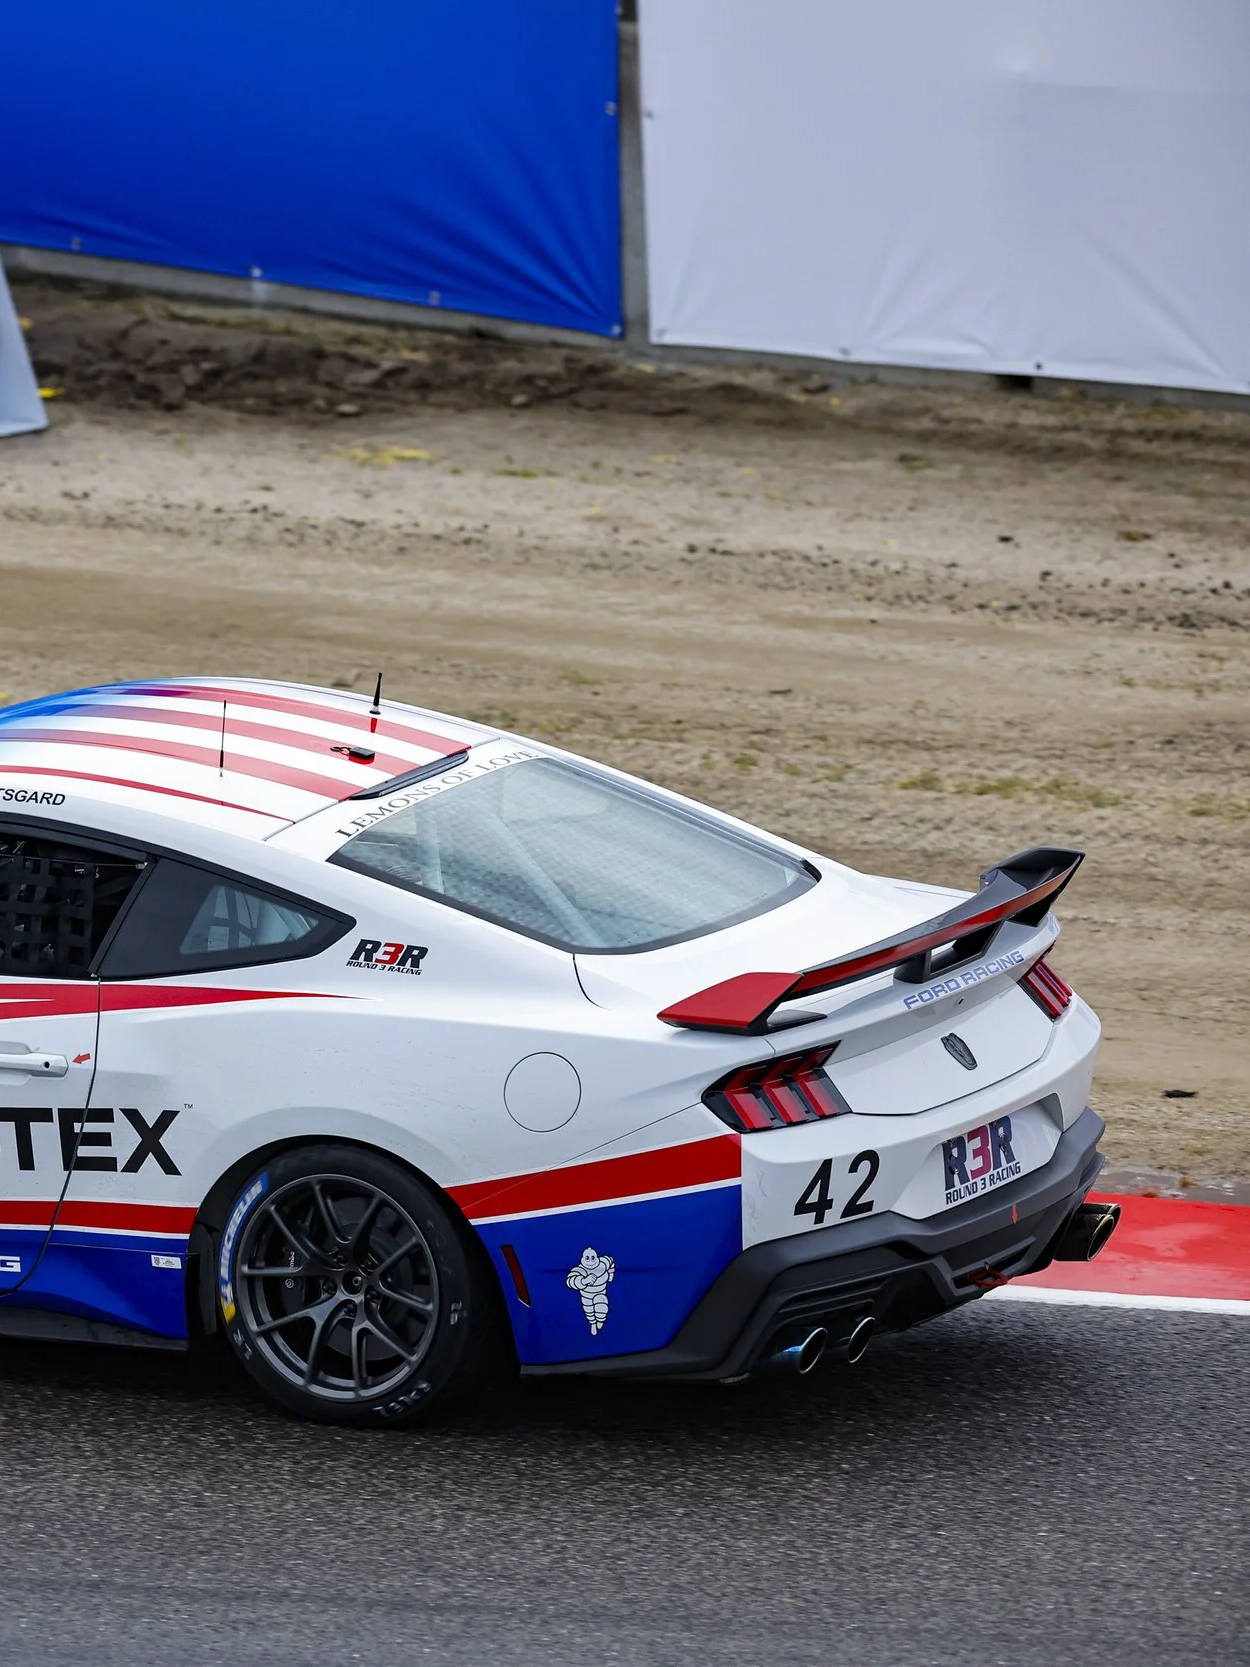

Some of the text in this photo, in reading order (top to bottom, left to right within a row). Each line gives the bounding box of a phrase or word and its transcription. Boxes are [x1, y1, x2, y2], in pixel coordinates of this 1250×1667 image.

[335, 749, 540, 838] LEMONS OF LOVE
[346, 960, 378, 970] ROUND
[387, 966, 422, 976] RACING
[349, 938, 429, 969] R3R
[903, 950, 1025, 1010] FORD RACING
[793, 1149, 881, 1226] 42
[941, 1115, 1016, 1192] R3R
[945, 1161, 1021, 1205] ROUND 3 RACING
[220, 1179, 264, 1281] MICHELIN
